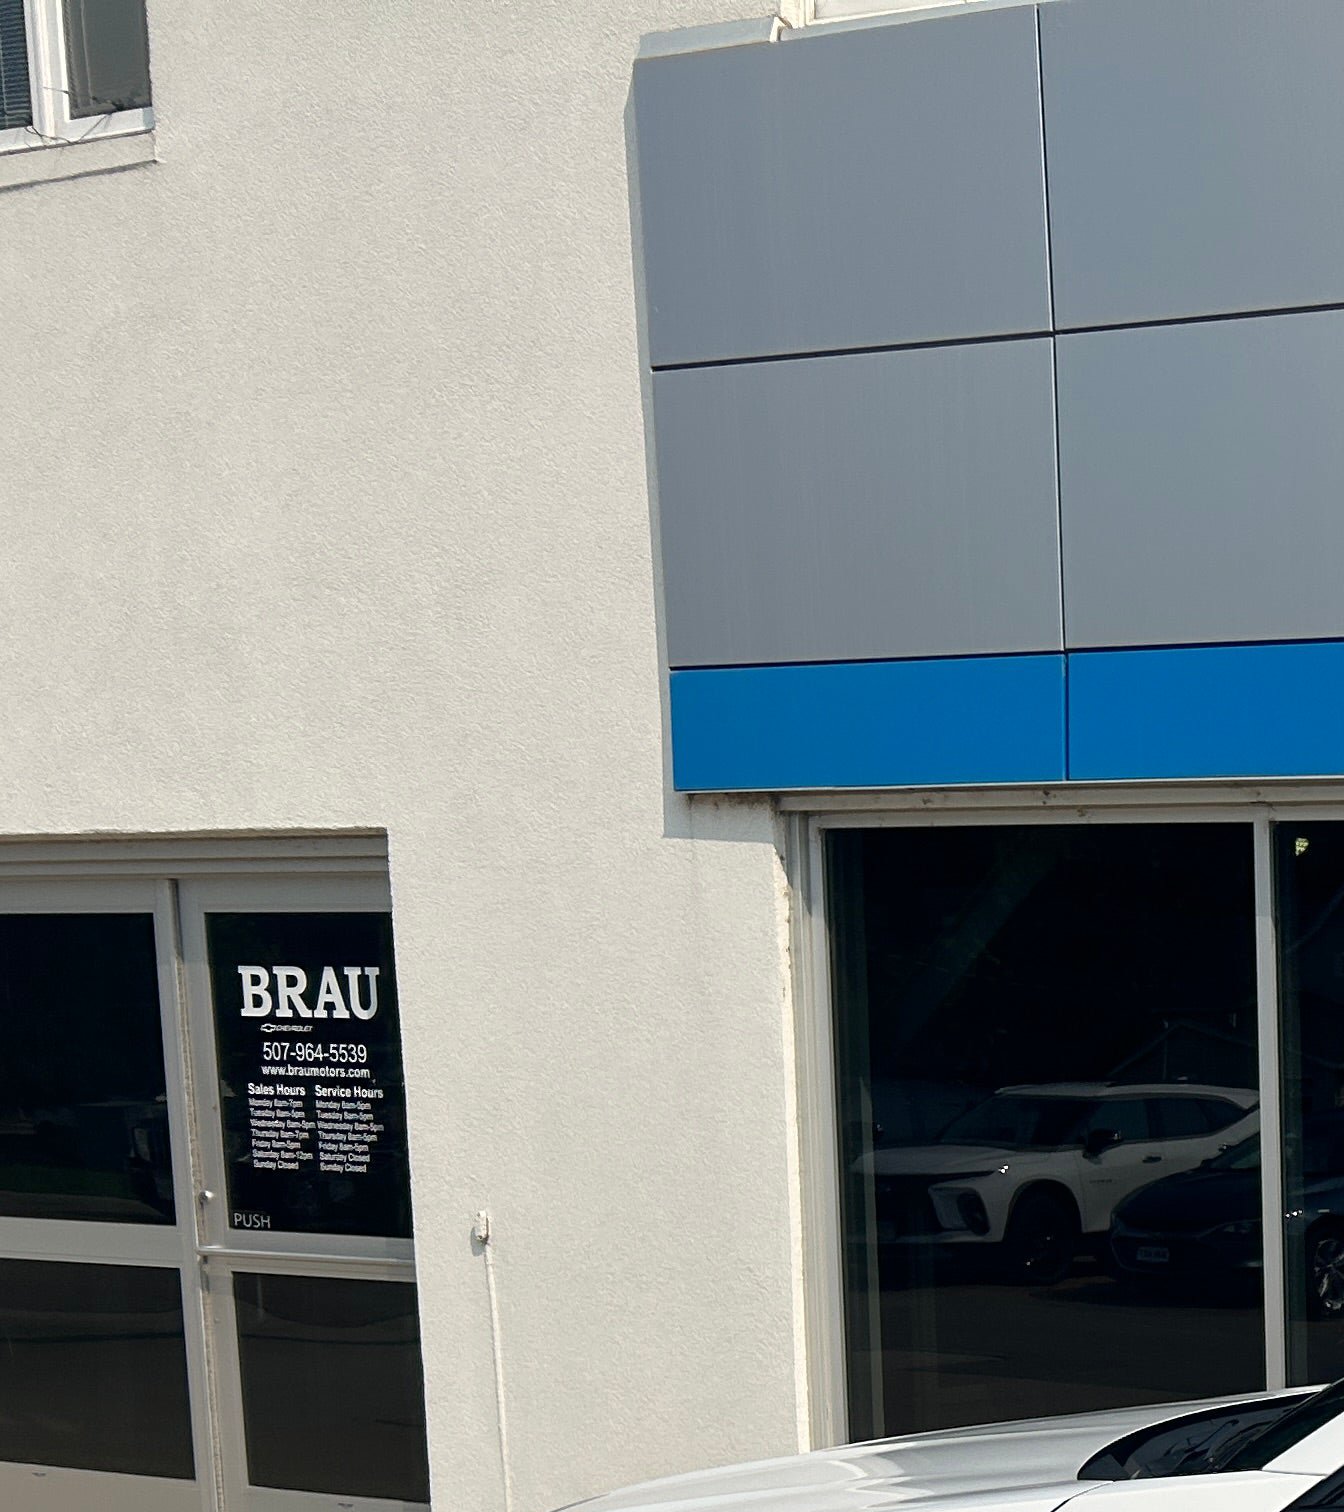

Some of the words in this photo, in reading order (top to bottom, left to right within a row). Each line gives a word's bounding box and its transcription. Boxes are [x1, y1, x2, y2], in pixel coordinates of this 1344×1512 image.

[237, 965, 380, 1020] BRAU
[262, 1042, 368, 1063] 507-964-5539
[261, 1064, 371, 1078] www.braumotors.com
[248, 1083, 275, 1095] Sales
[276, 1084, 306, 1096] Hours
[314, 1084, 352, 1098] Service
[353, 1086, 384, 1099] Hours
[233, 1212, 271, 1229] PUSH
